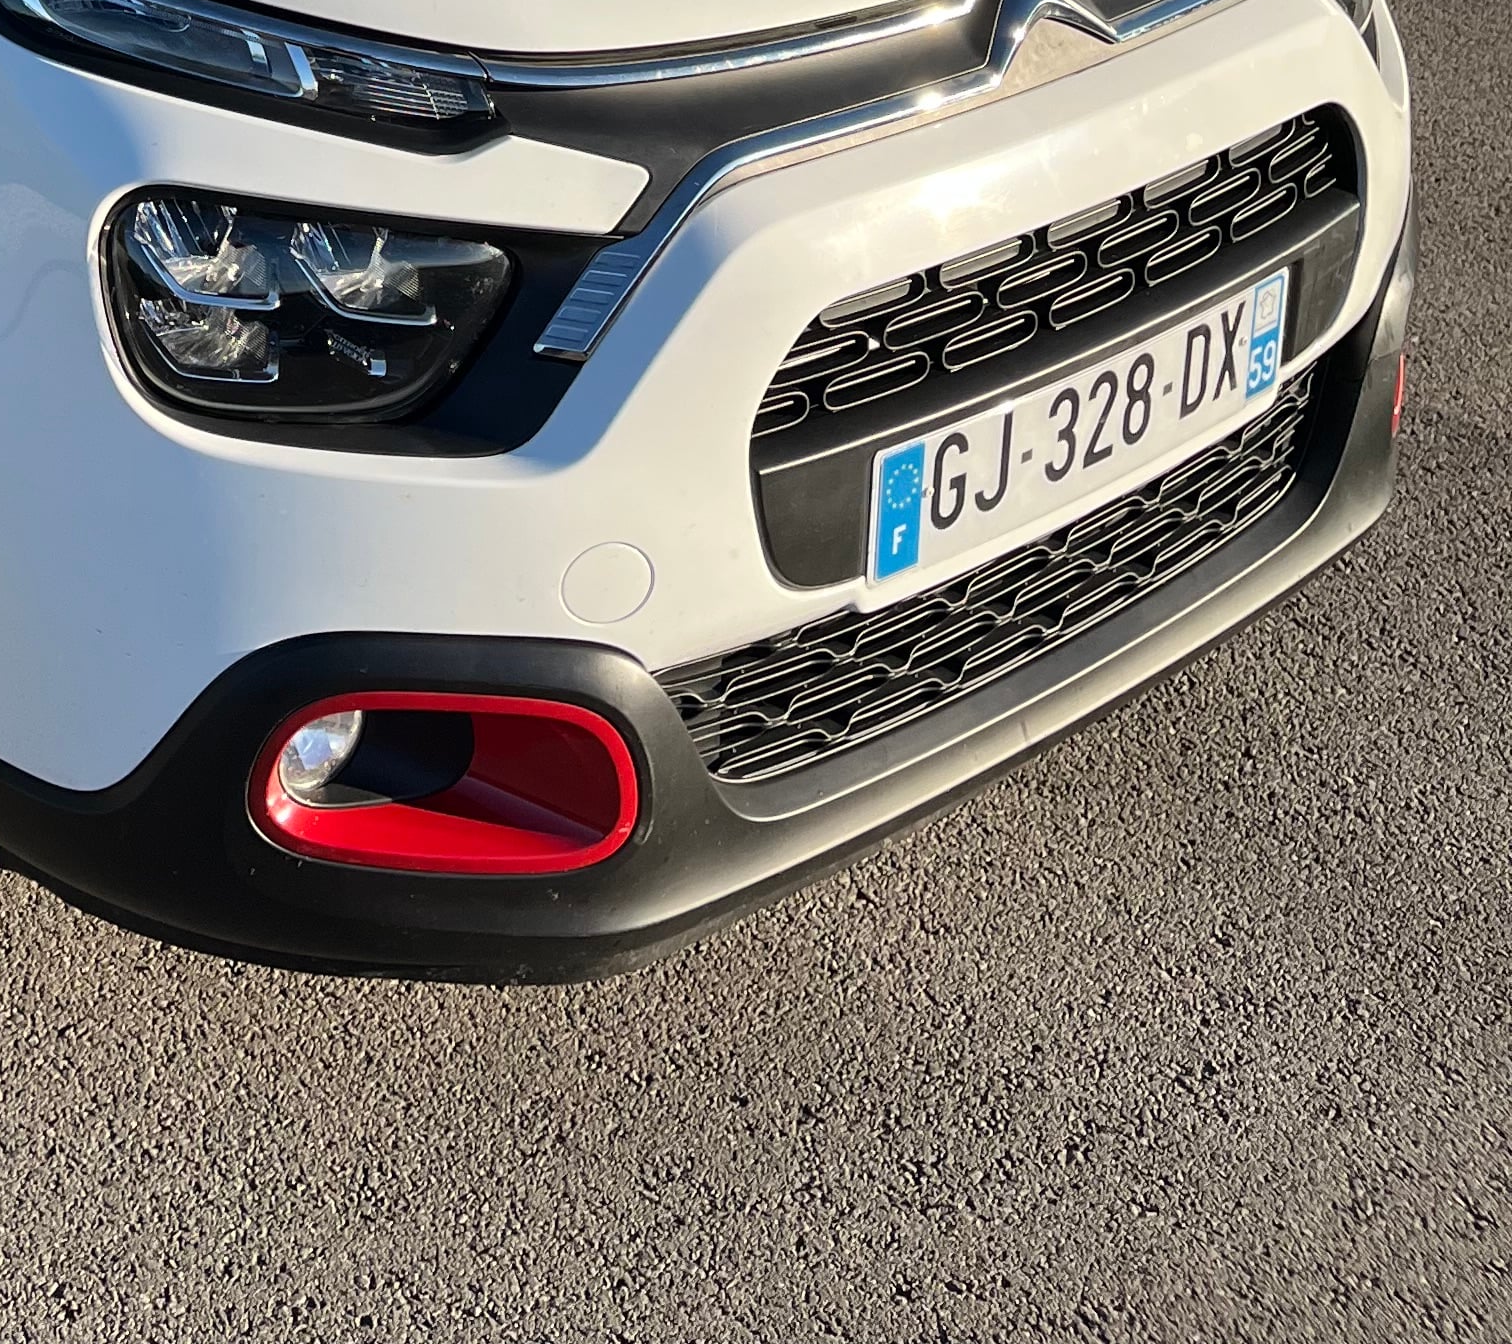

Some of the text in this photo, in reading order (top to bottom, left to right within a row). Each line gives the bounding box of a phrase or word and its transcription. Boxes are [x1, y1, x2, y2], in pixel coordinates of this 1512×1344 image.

[1248, 339, 1277, 389] 59
[929, 300, 1246, 531] GJ-328-DX
[892, 523, 907, 555] F
